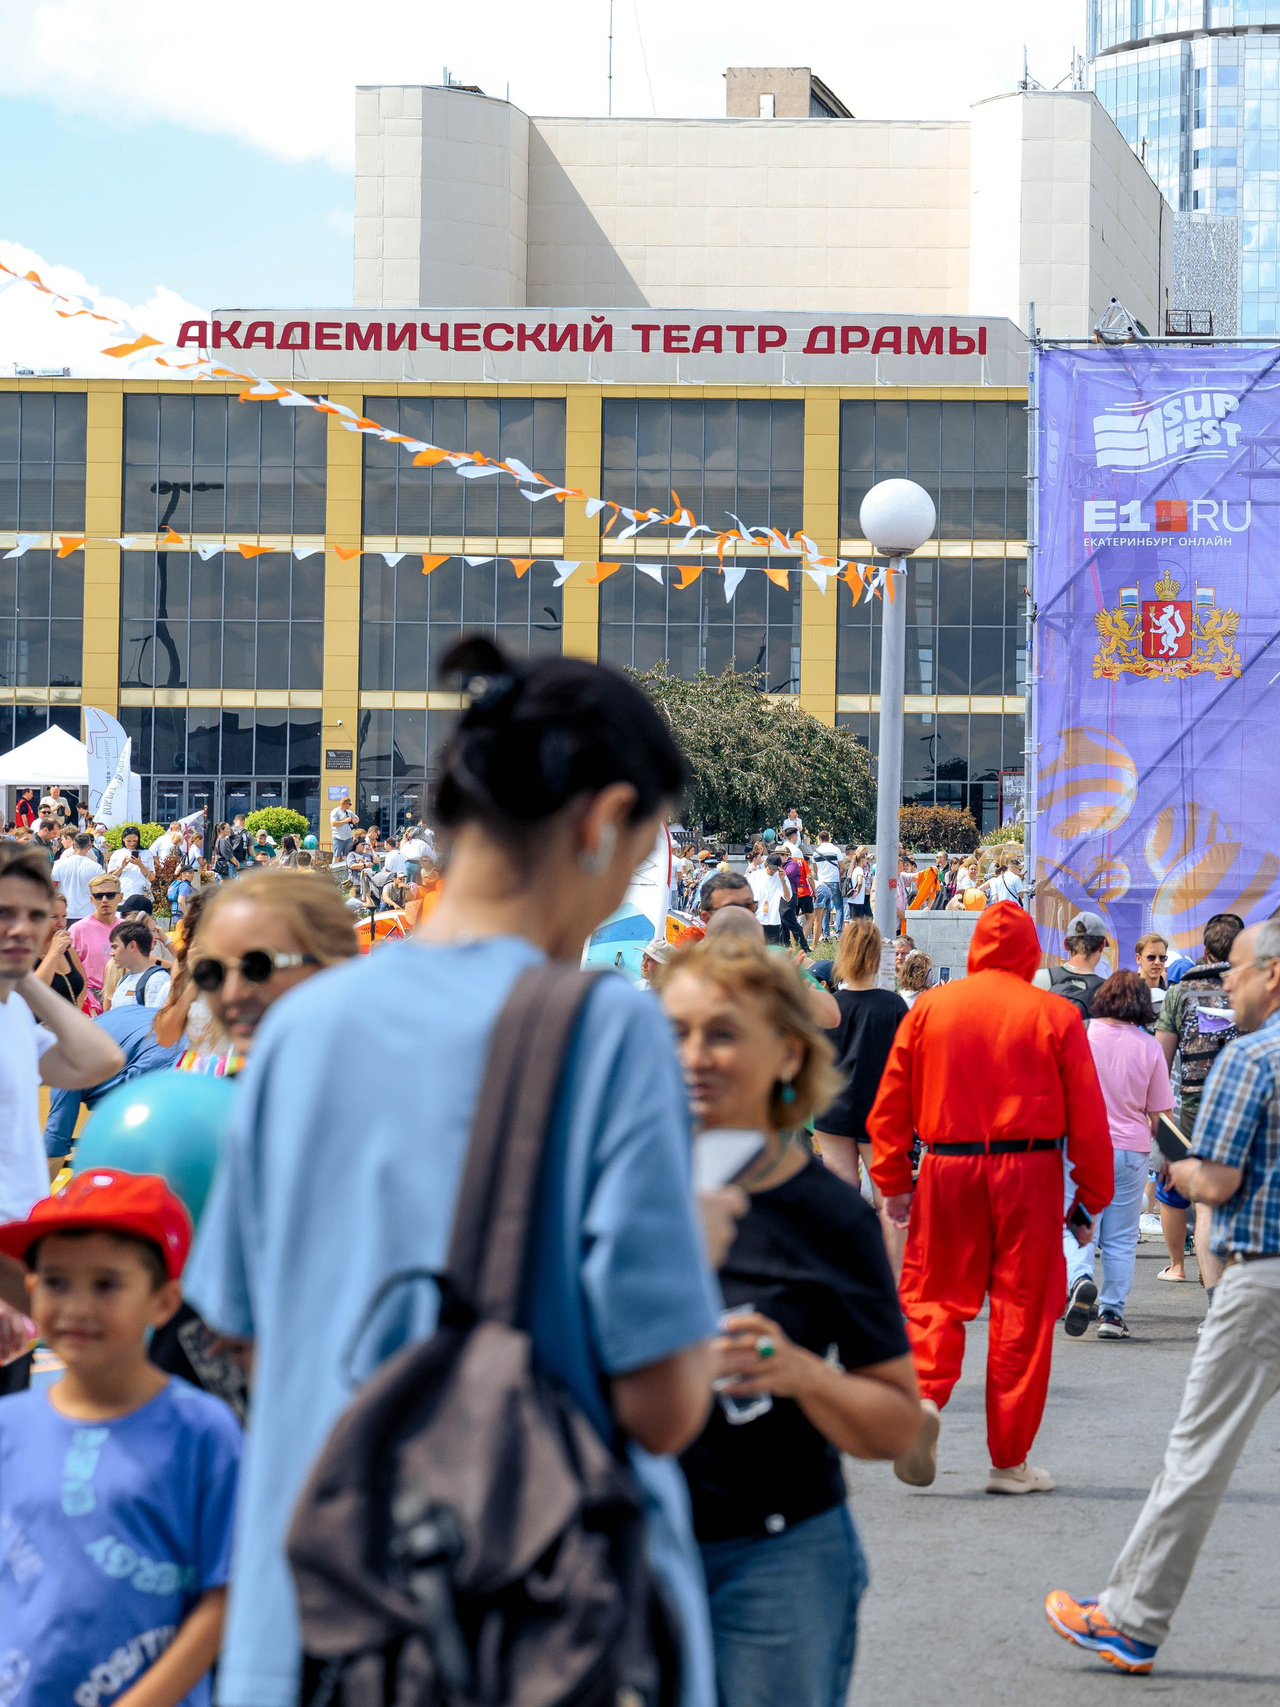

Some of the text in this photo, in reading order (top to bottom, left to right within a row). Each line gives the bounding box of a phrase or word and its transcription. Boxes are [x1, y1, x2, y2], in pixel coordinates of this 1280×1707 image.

[177, 315, 987, 355] АКАДЕМИЧЕСКИЙ ТЕАТР ДРАМЫ
[1093, 393, 1242, 468] E1 SUP
[1167, 419, 1242, 456] FEST
[1084, 500, 1252, 532] E1 RU
[1084, 535, 1232, 547] ЕКАТЕРИНБУРГ ОНЛАЙН
